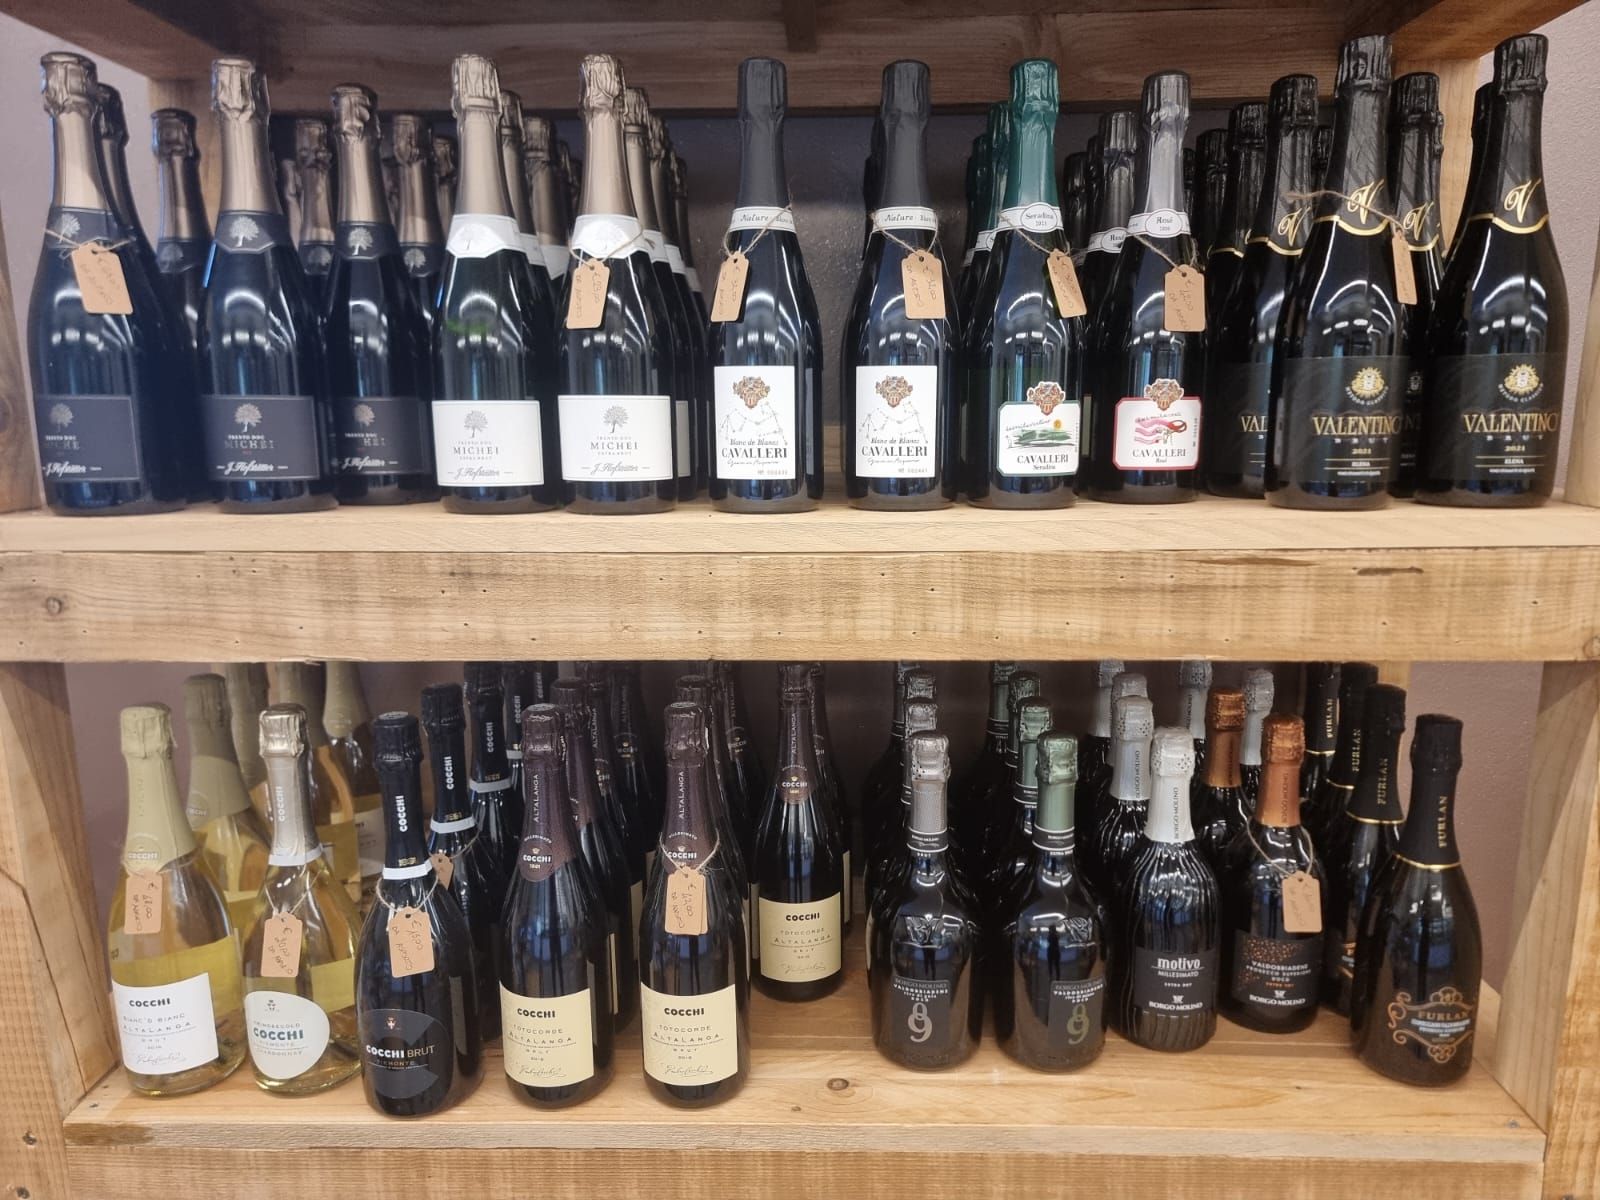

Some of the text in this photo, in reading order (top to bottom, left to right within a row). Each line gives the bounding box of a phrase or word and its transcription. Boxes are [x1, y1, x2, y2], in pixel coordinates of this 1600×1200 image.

[721, 447, 788, 459] CAVALLERI
[861, 446, 929, 457] CAVALLERI
[1132, 448, 1186, 458] CAVALLERI
[1016, 454, 1069, 464] CAVALLERI
[486, 722, 494, 753] COCCHI
[444, 755, 454, 790] COCCHI
[781, 780, 808, 788] COCCHI
[1377, 757, 1389, 806] FURLAN
[275, 785, 286, 822] COCCHI
[395, 795, 408, 833] COCCHI
[1438, 795, 1448, 849] FURLAN
[523, 854, 552, 863] COCCHI
[667, 852, 697, 860] COCCHI
[785, 912, 820, 921] COCCHI
[129, 998, 171, 1008] COCCHI
[1148, 1000, 1203, 1011] BORGO MOLINO
[517, 1008, 556, 1018] COCCHI
[664, 1007, 705, 1017] COCCHI
[253, 1027, 304, 1041] COCCHI
[365, 1044, 435, 1058] COCCHI BRUT
